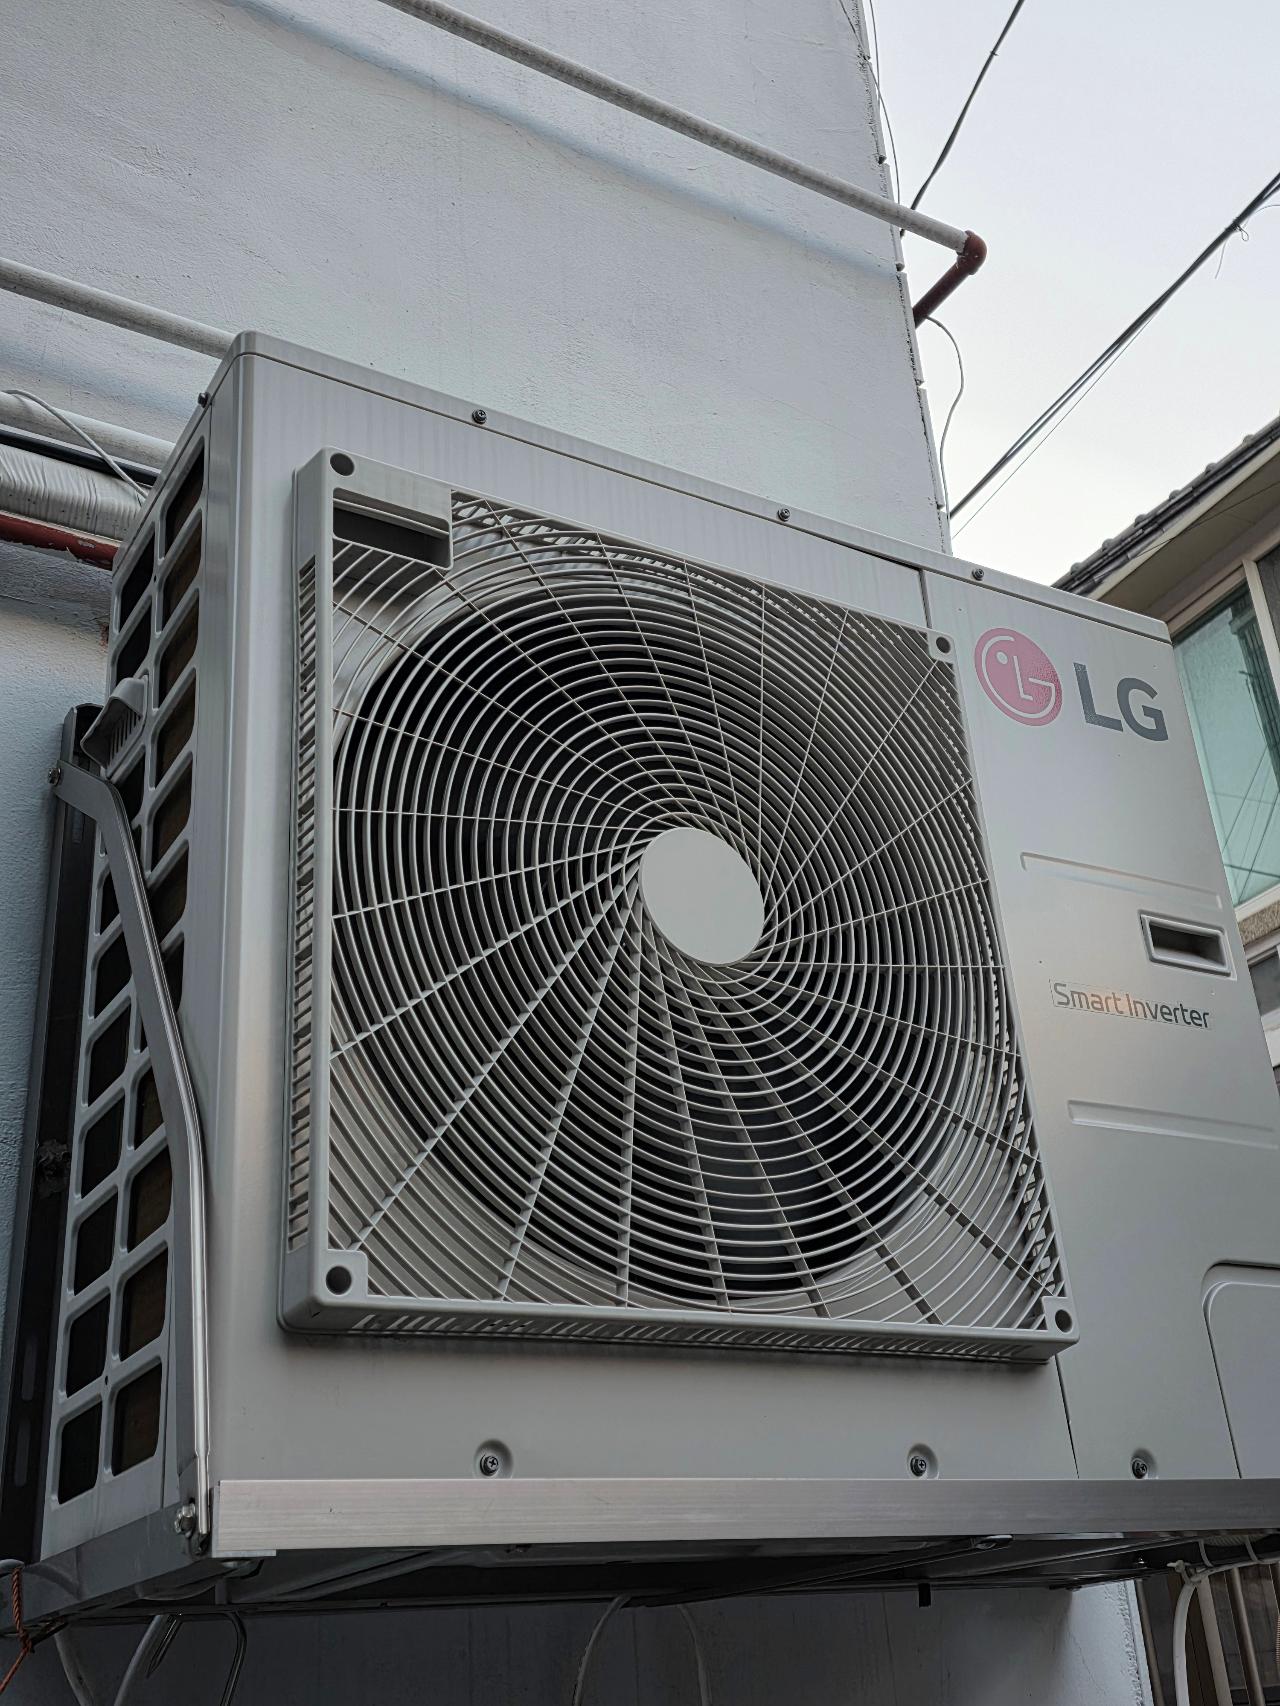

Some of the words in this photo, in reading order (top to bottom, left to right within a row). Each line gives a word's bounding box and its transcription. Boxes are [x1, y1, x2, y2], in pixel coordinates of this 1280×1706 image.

[1073, 662, 1168, 741] LG
[1053, 982, 1124, 1014] Smart
[1126, 993, 1209, 1028] Inverter
